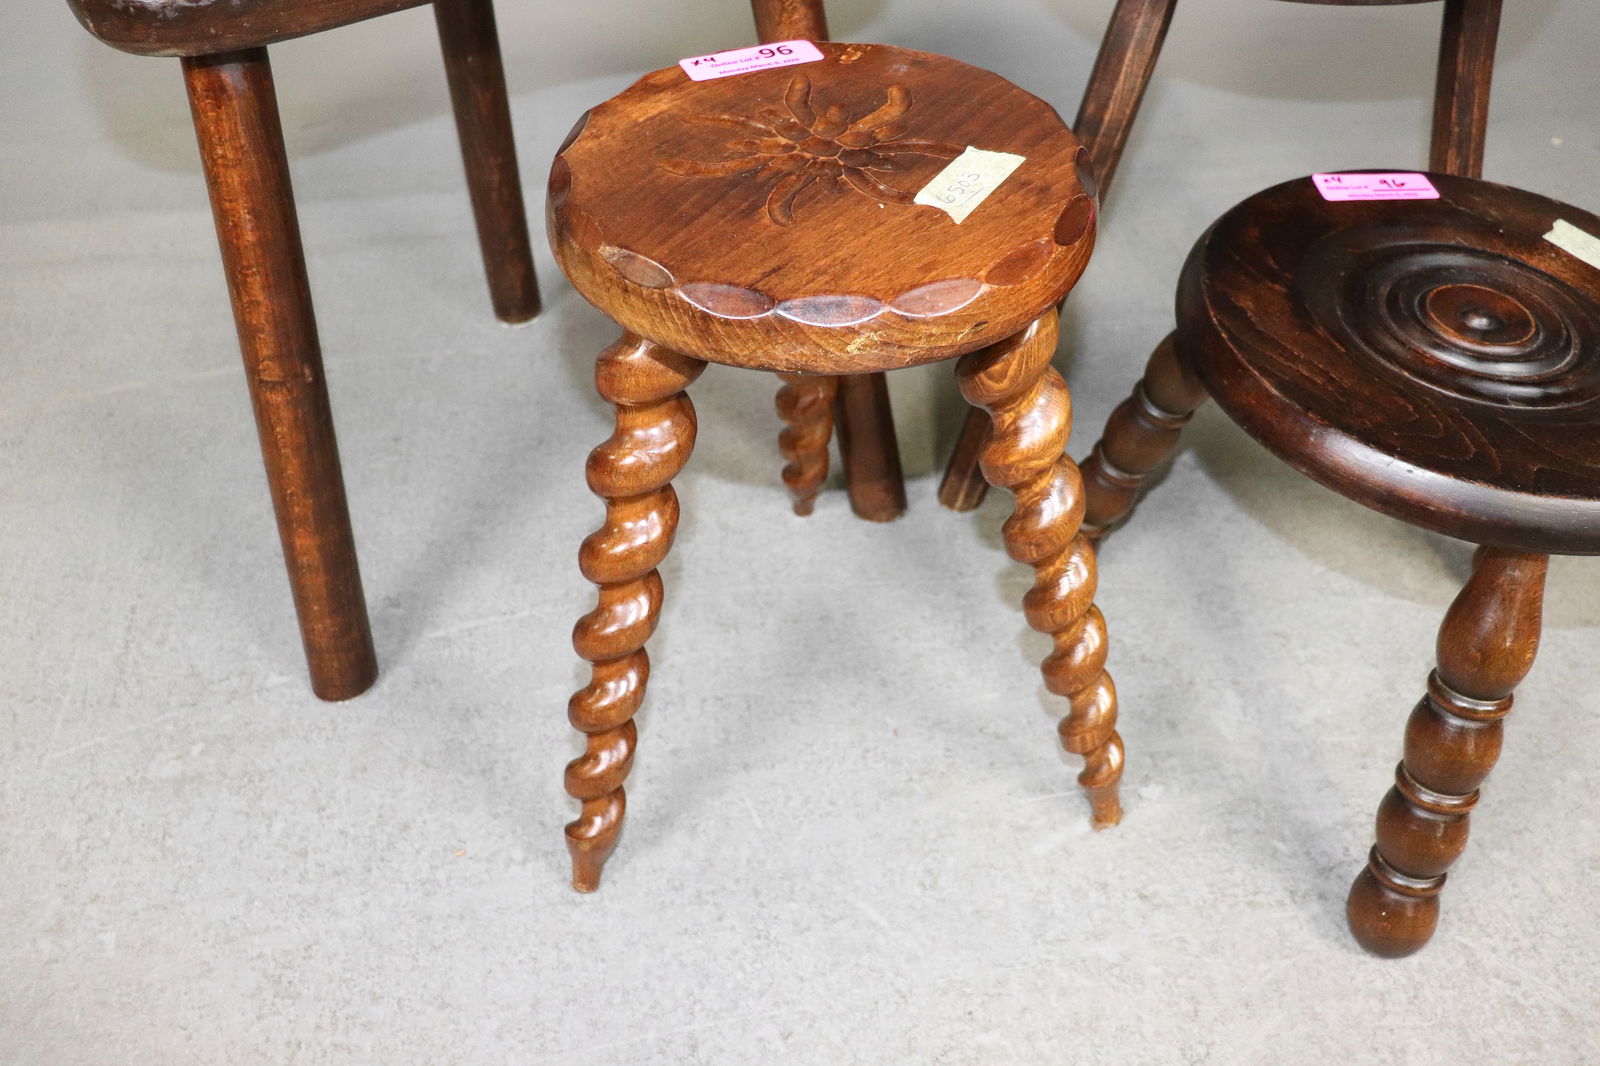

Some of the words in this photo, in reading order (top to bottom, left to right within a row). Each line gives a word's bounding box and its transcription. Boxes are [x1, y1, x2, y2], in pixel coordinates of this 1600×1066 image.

[758, 45, 794, 59] 96
[710, 60, 738, 69] Online
[719, 66, 749, 75] Monday
[1379, 178, 1406, 189] 96
